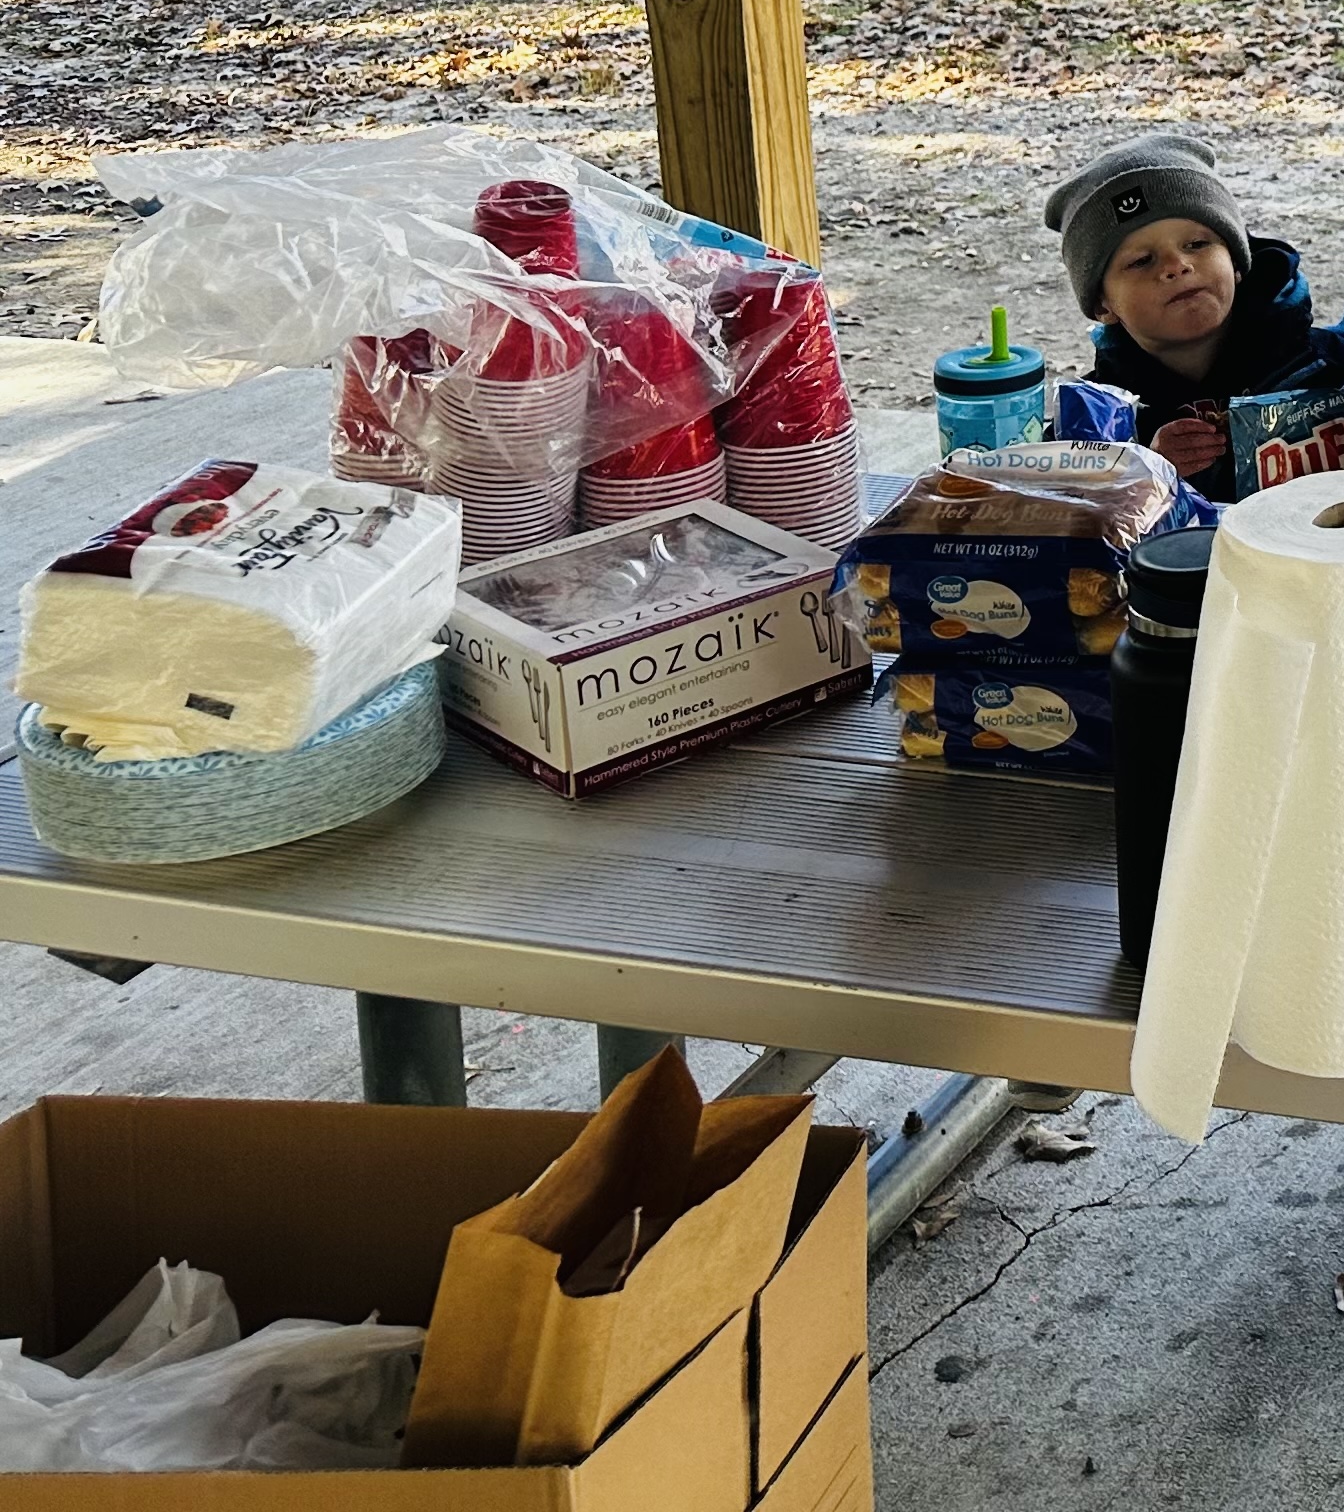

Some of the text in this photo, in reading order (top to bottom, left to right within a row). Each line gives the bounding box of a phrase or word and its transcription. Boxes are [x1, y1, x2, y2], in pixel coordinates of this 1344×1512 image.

[966, 451, 1107, 473] Hot Dog Buns
[933, 542, 1040, 560] NET WT 11 OZ (312g)
[932, 580, 963, 594] Great
[551, 586, 729, 645] mozaïk
[959, 608, 986, 622] Dog
[988, 607, 1019, 620] Buns
[437, 624, 511, 681] ozaïk
[576, 611, 776, 707] mozaïk
[596, 658, 751, 722] easy elegant entertaining
[606, 695, 755, 757] 80 Forks 40 Knives 40 Spoons
[647, 696, 715, 730] 160 Pieces
[981, 711, 1065, 727] Hot Dog Buns
[583, 697, 803, 787] Hammered Style Premium Plastic Cutlery
